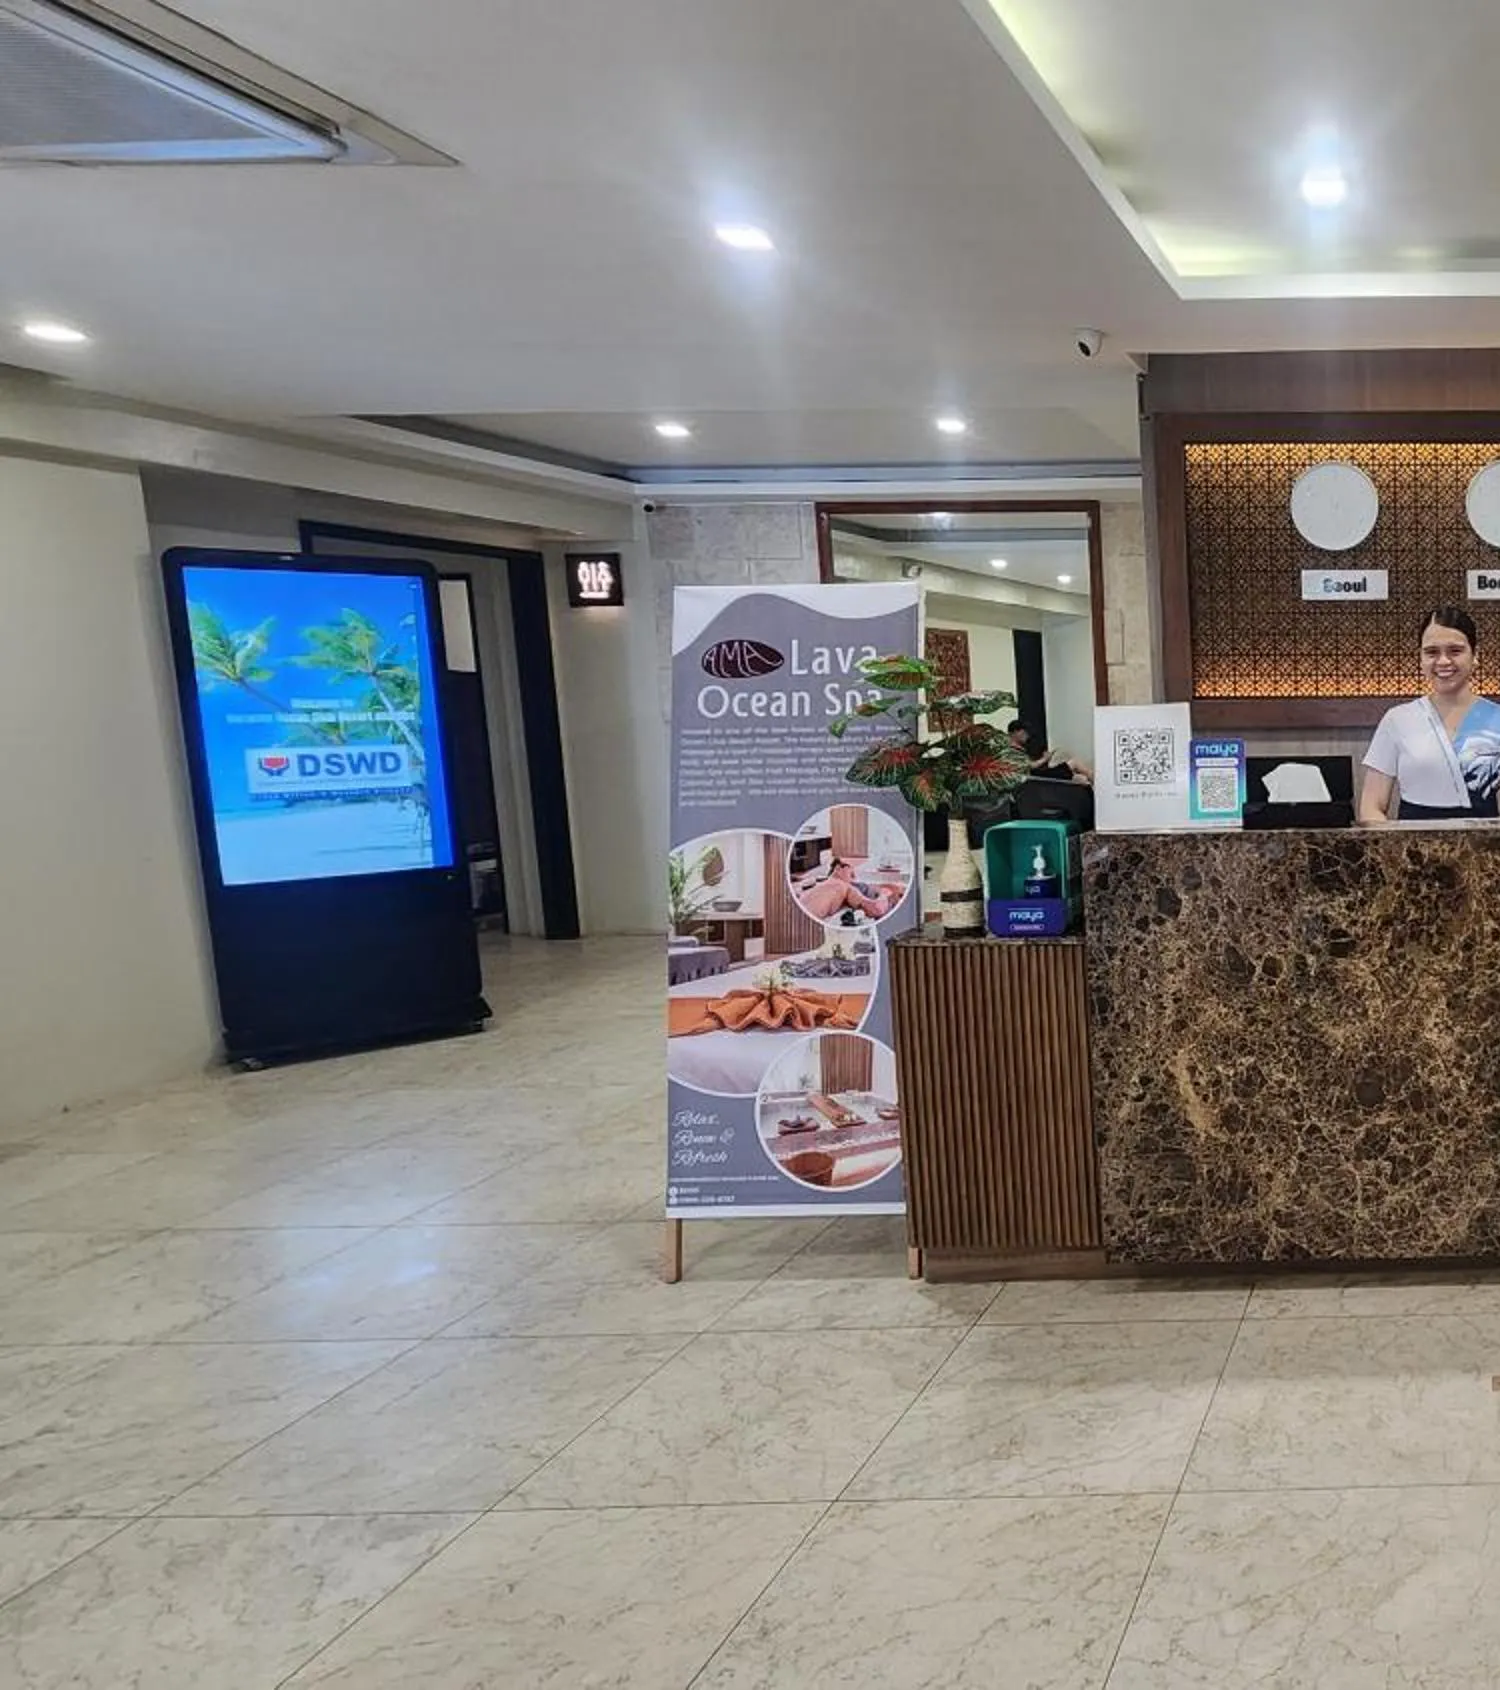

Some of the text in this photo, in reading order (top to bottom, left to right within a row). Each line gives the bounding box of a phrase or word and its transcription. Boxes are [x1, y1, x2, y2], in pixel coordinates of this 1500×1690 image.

[1323, 576, 1367, 593] Seoul
[697, 685, 811, 719] Ocean
[1194, 742, 1239, 757] maya
[296, 751, 402, 777] DSWD
